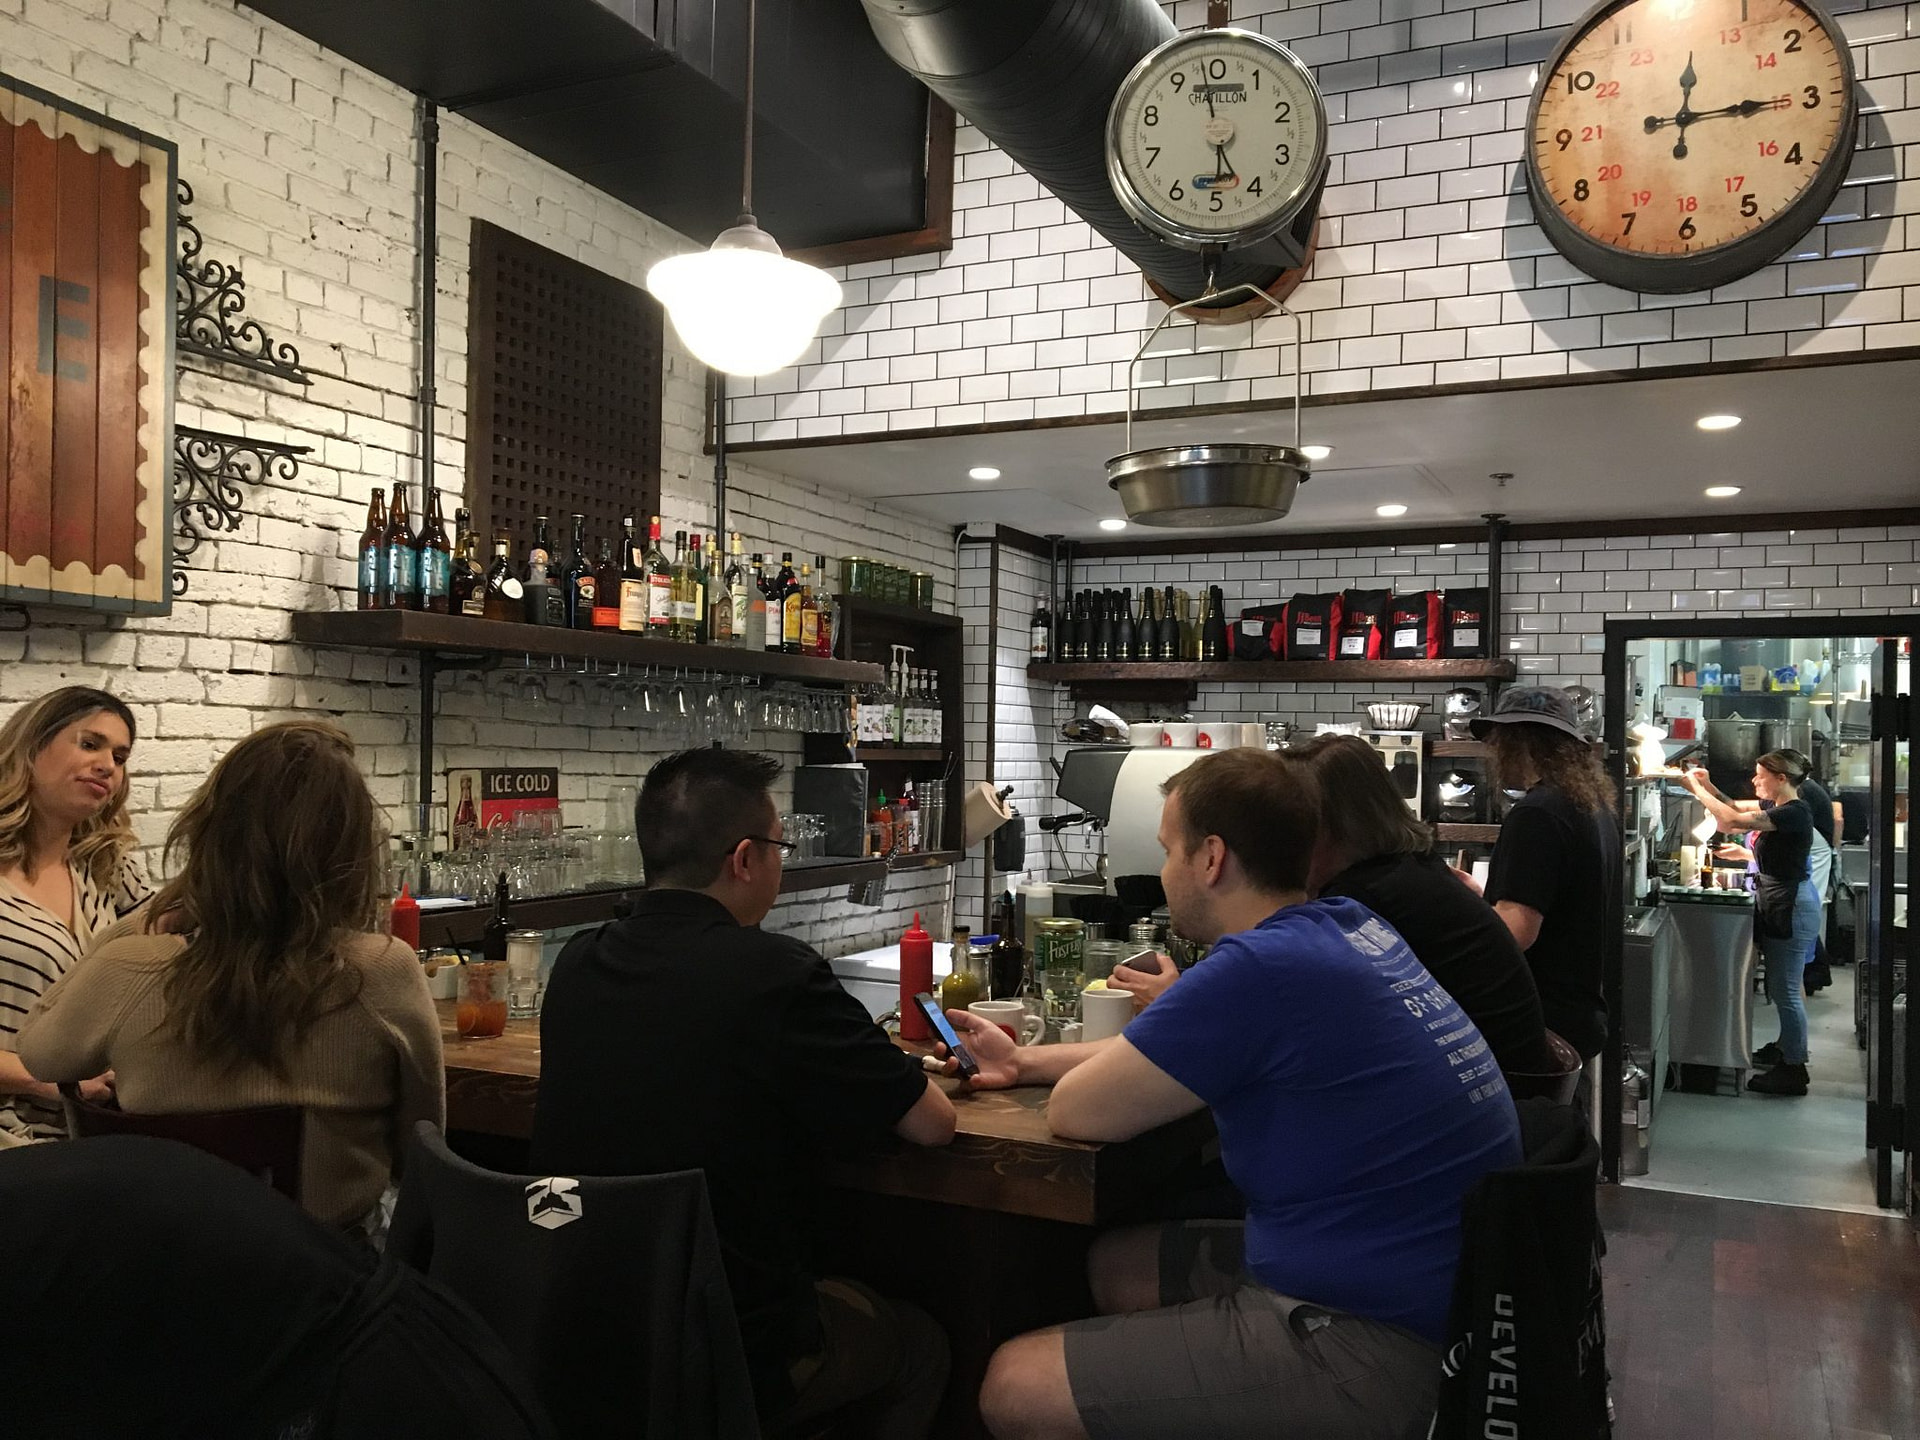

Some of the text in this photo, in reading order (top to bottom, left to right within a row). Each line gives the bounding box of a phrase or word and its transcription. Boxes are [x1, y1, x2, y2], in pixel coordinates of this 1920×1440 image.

[1719, 27, 1742, 45] 13
[1783, 29, 1802, 54] 2
[1209, 58, 1227, 80] 0
[1630, 48, 1655, 67] 23
[1755, 53, 1777, 70] 14
[1170, 71, 1186, 94] 9
[1251, 69, 1260, 91] 1
[1567, 70, 1595, 95] 10
[1595, 81, 1620, 99] 22
[1801, 85, 1821, 110] 3
[1144, 104, 1159, 127] 8
[1274, 101, 1292, 124] 2
[1555, 128, 1573, 152] 9
[1581, 124, 1603, 142] 21
[1145, 146, 1161, 169] 7
[1274, 143, 1290, 166] 3
[1757, 140, 1779, 158] 16
[1784, 142, 1804, 166] 4
[1597, 163, 1623, 182] 20
[1169, 180, 1185, 201] 6
[1246, 176, 1263, 198] 4
[1573, 178, 1590, 202] 8
[1724, 175, 1745, 194] 17
[1208, 190, 1223, 213] 5
[1632, 190, 1652, 208] 19
[1677, 196, 1698, 213] 18
[1739, 193, 1758, 218] 5
[1621, 212, 1637, 237] 7
[1678, 217, 1697, 241] 6
[37, 275, 90, 383] E
[490, 774, 550, 793] ICE COLD
